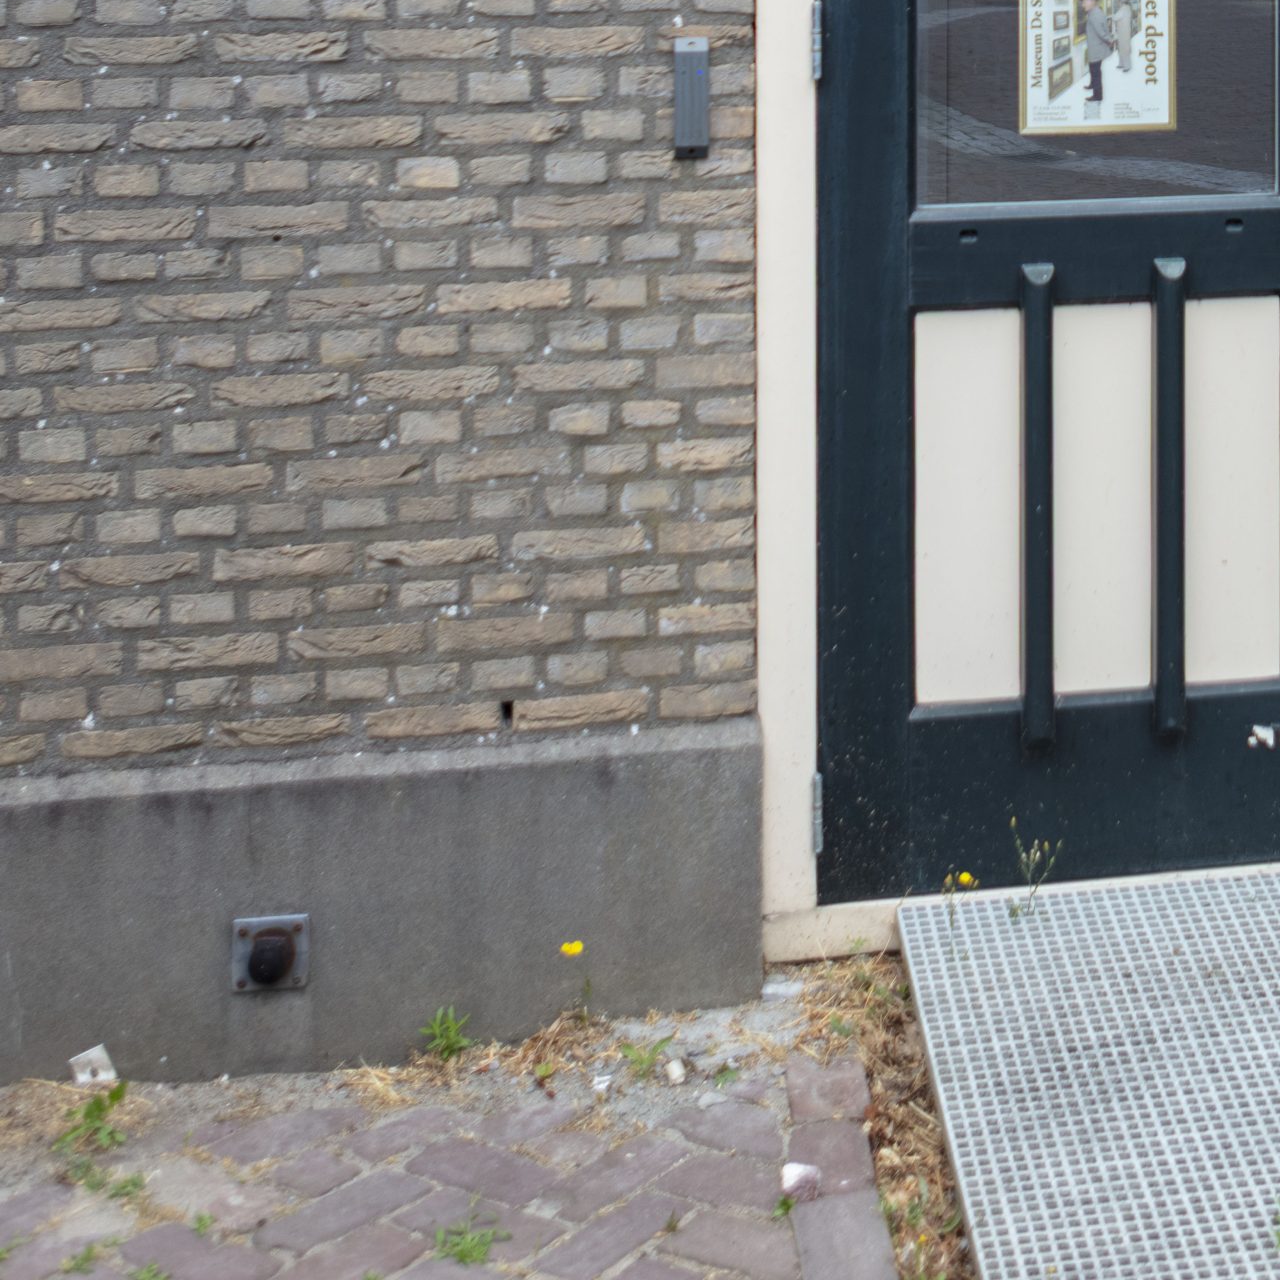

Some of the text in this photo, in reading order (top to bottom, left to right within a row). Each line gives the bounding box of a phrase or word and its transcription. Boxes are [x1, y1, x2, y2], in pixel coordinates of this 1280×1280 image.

[1031, 10, 1042, 29] De
[1031, 34, 1042, 88] Museum
[1139, 25, 1164, 85] depot
